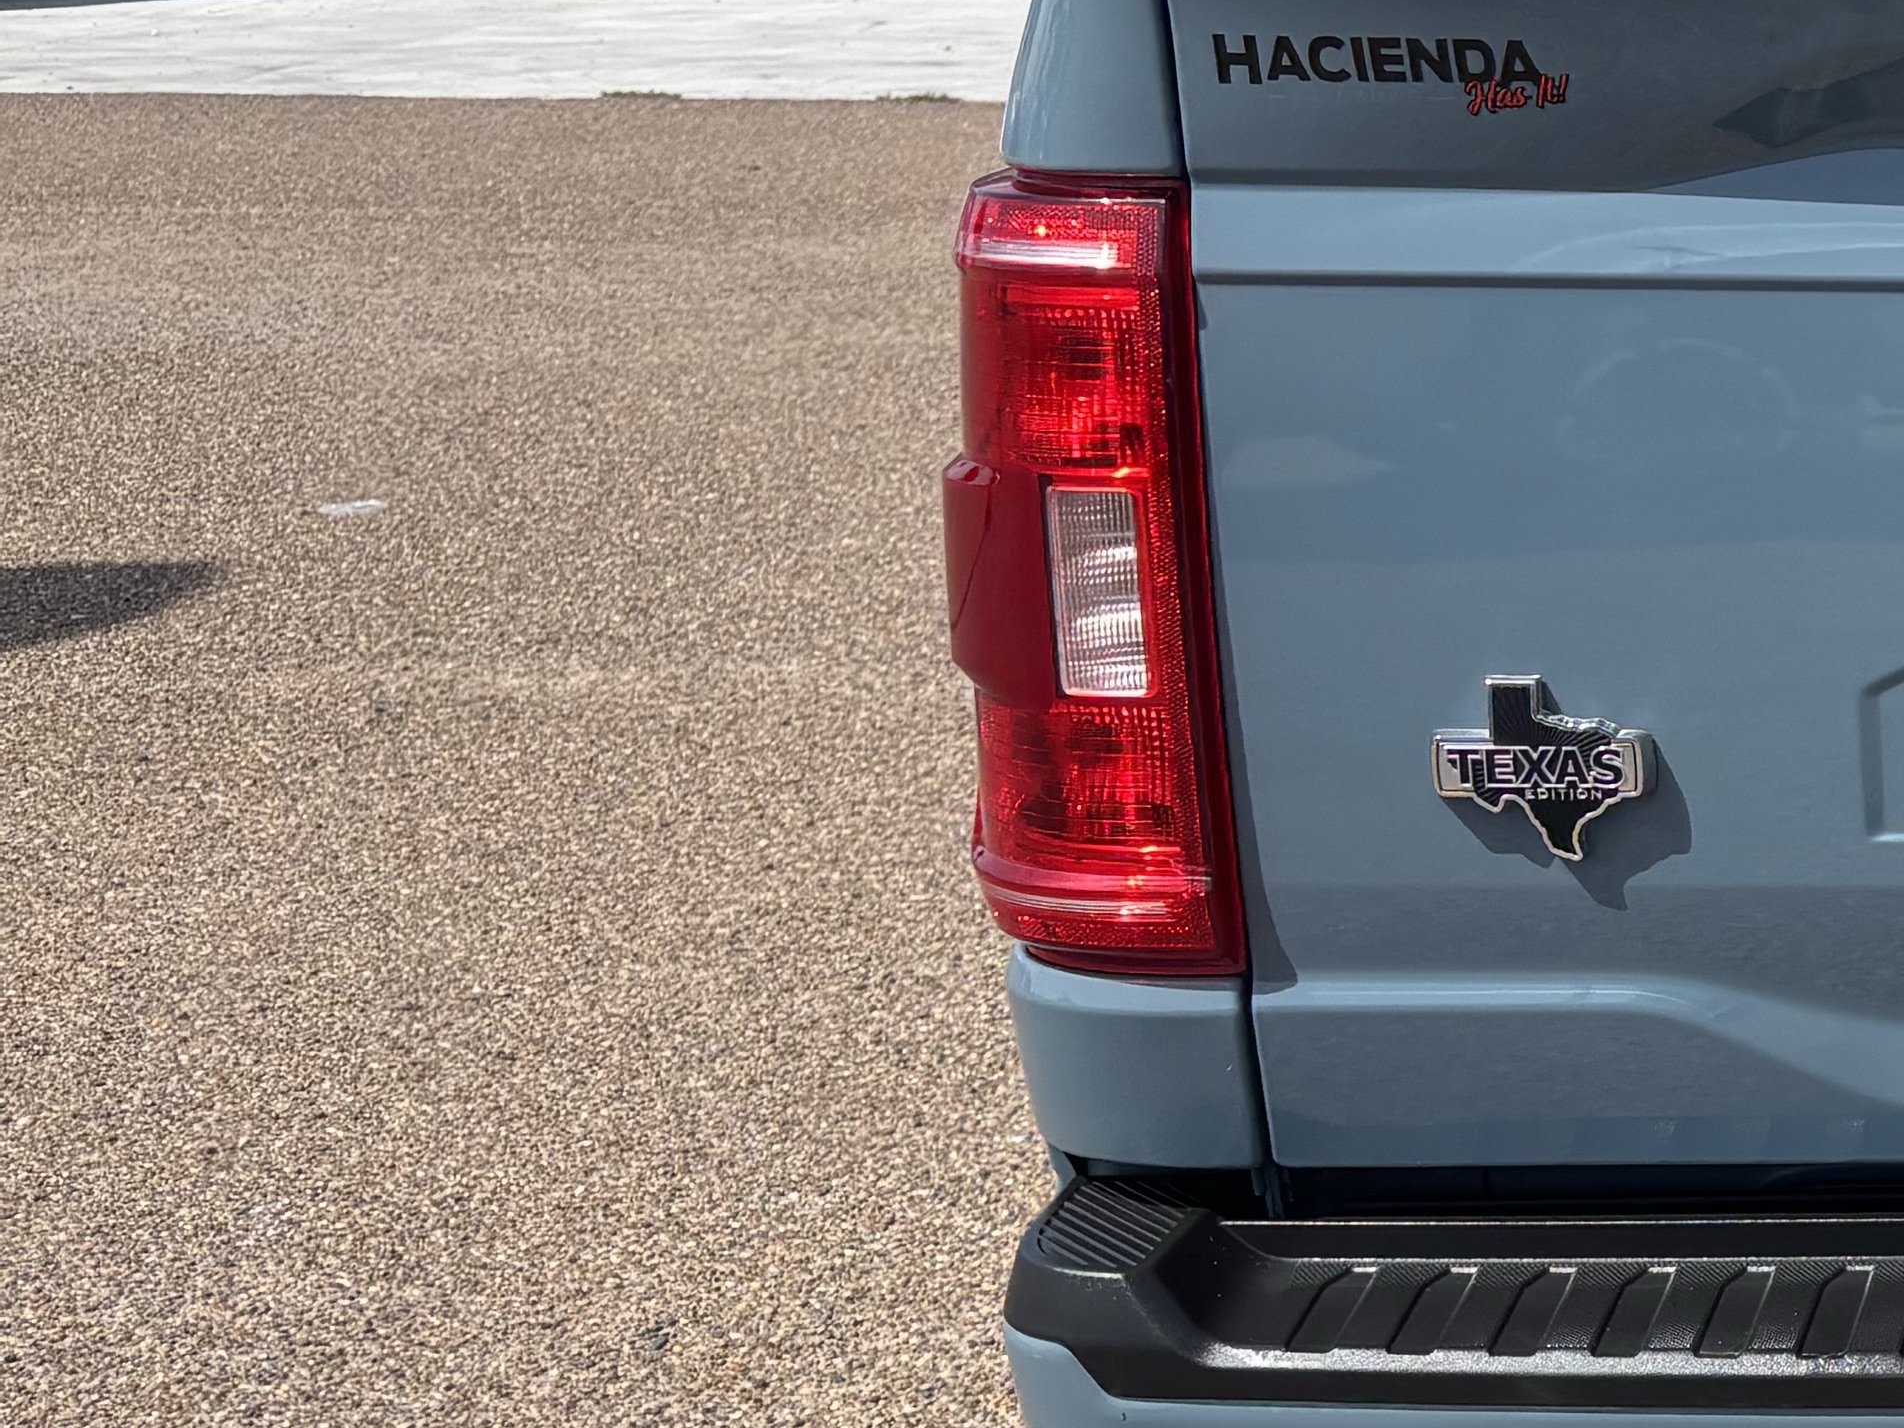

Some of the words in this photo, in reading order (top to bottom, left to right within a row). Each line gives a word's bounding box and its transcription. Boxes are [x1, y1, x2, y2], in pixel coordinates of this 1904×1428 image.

[1212, 33, 1547, 85] HACIENDA
[1464, 77, 1529, 116] Has
[1441, 745, 1628, 789] TEXAS
[1525, 787, 1603, 802] EDITION
